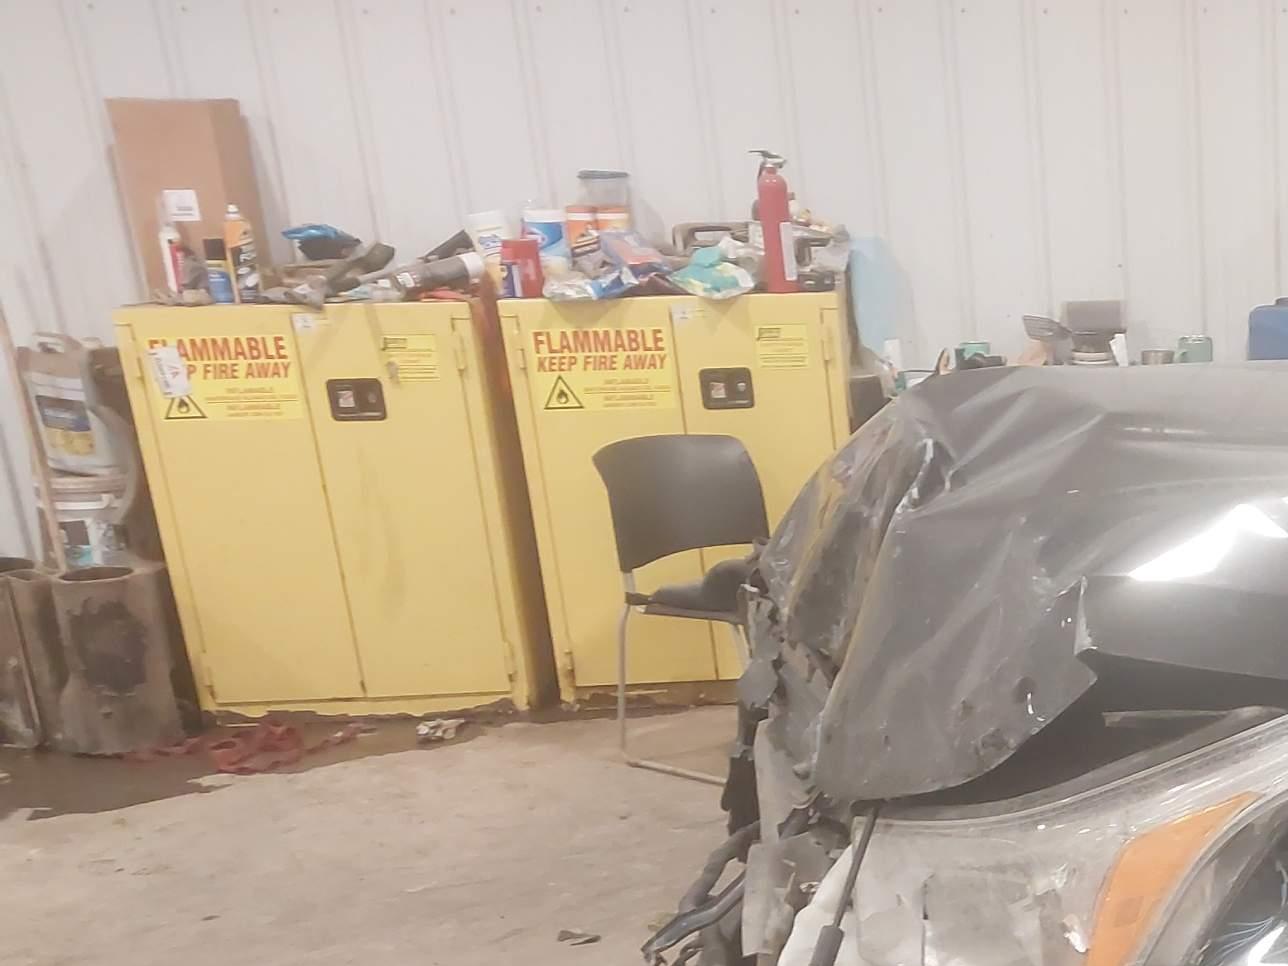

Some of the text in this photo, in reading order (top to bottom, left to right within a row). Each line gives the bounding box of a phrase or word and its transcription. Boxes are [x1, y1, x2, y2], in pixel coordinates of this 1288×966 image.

[148, 336, 288, 361] AMMABLE
[532, 329, 665, 354] FLAMMABLE
[203, 363, 240, 380] FIRE
[245, 361, 290, 379] AWAY
[537, 354, 667, 372] KEEP FIRE AWAY
